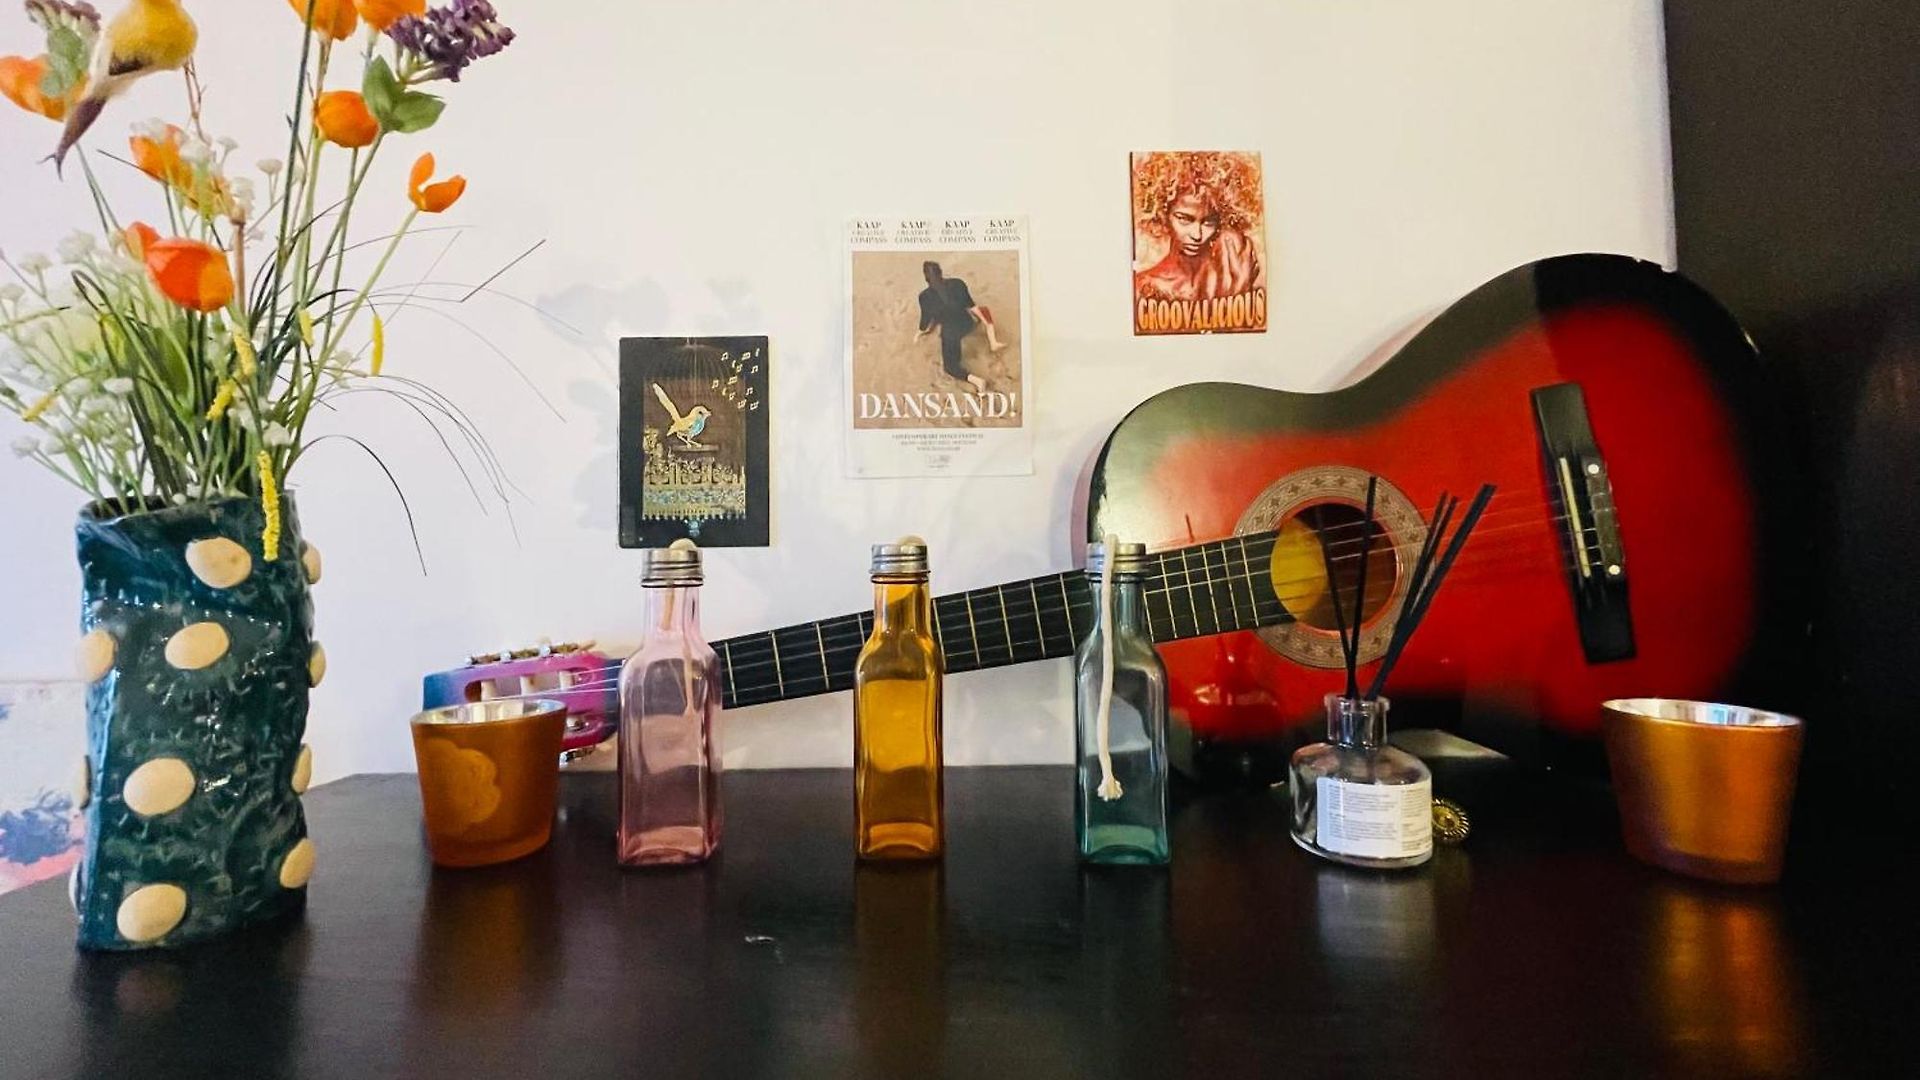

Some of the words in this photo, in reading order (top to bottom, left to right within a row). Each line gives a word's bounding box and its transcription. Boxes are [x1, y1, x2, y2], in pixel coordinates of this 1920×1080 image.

[856, 221, 882, 229] KAAP
[901, 220, 926, 229] KAAP
[945, 220, 970, 228] KAAP
[990, 219, 1015, 228] KAAP
[850, 236, 888, 244] COMPASS
[939, 235, 976, 243] COMPASS
[1137, 288, 1266, 330] GROOVALICIOUS
[859, 392, 1017, 419] DANSAND!
